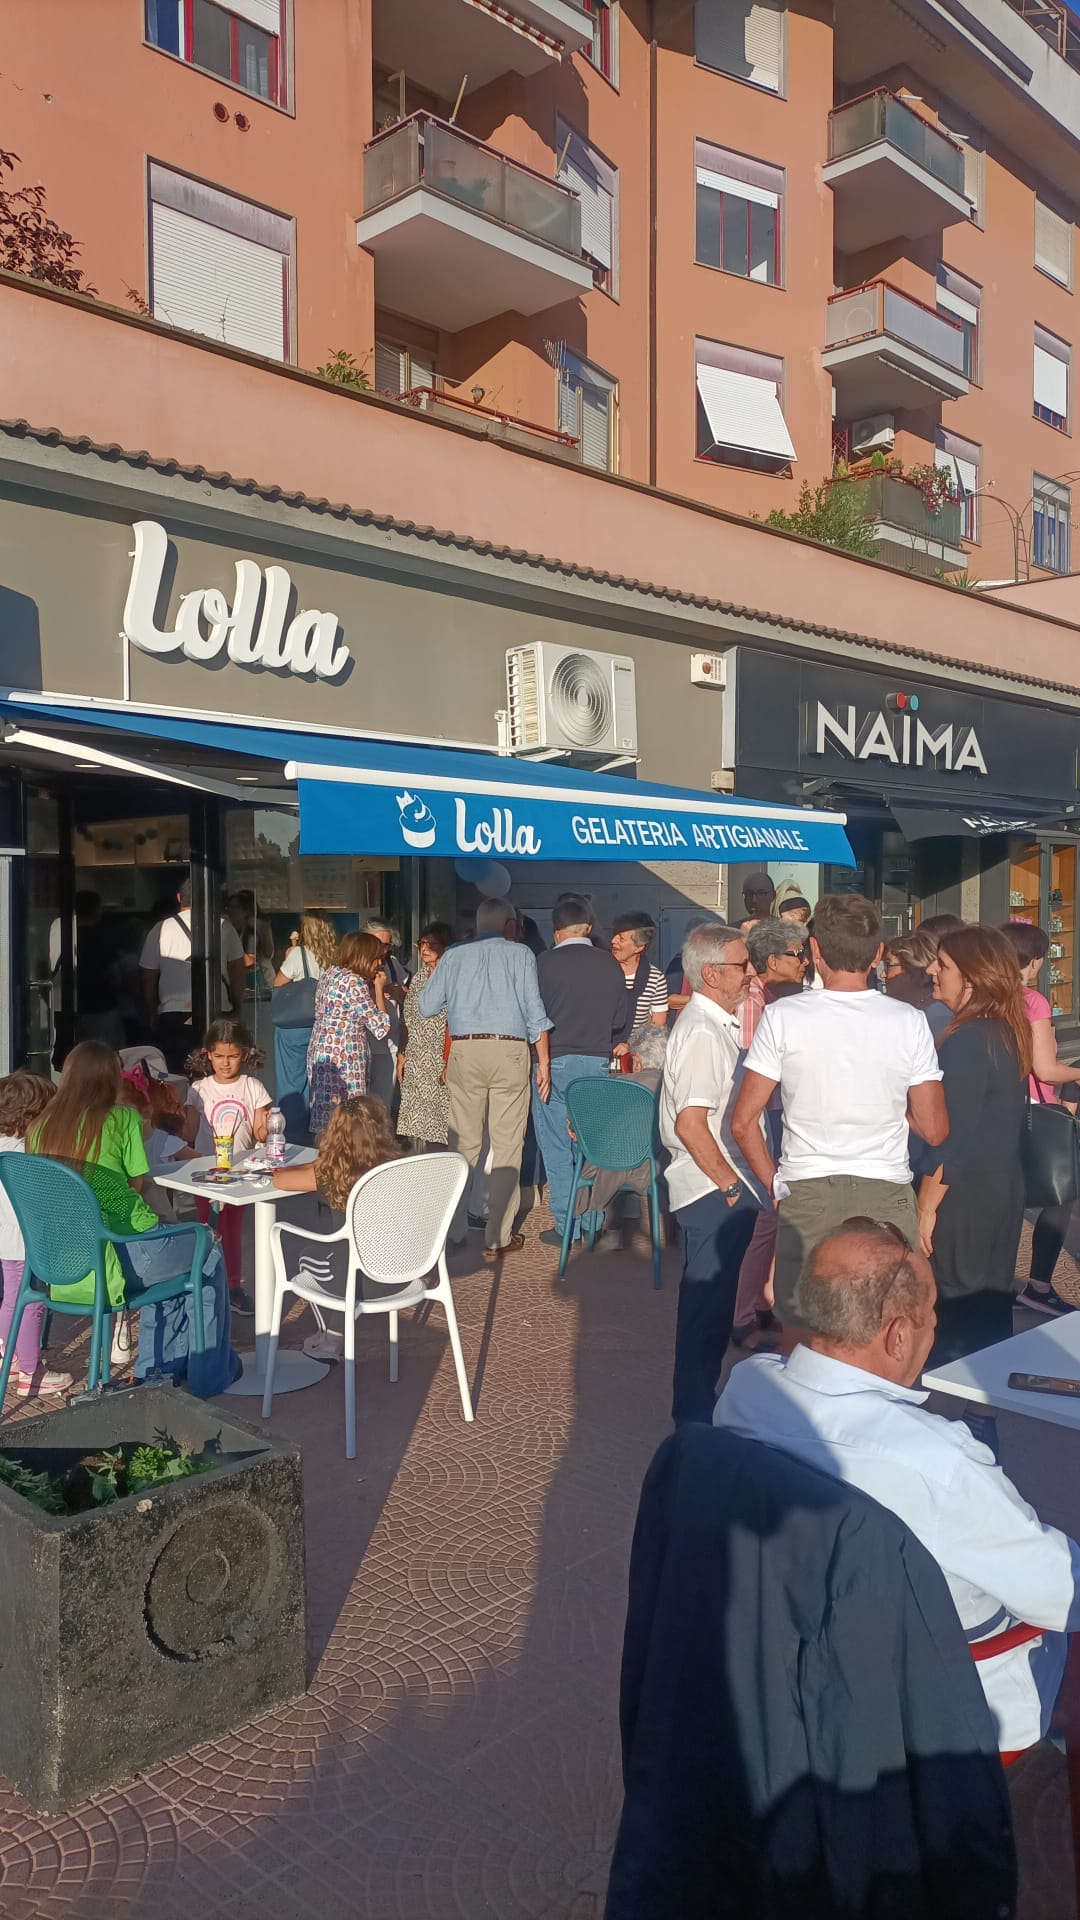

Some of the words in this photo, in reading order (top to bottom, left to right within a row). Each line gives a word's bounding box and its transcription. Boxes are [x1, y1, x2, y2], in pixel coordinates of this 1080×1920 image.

[123, 520, 350, 678] Lolla
[816, 700, 988, 774] NAIMA
[455, 798, 541, 854] Lolla
[572, 815, 687, 846] GELATERIA
[693, 823, 809, 851] ARTIGIANALE
